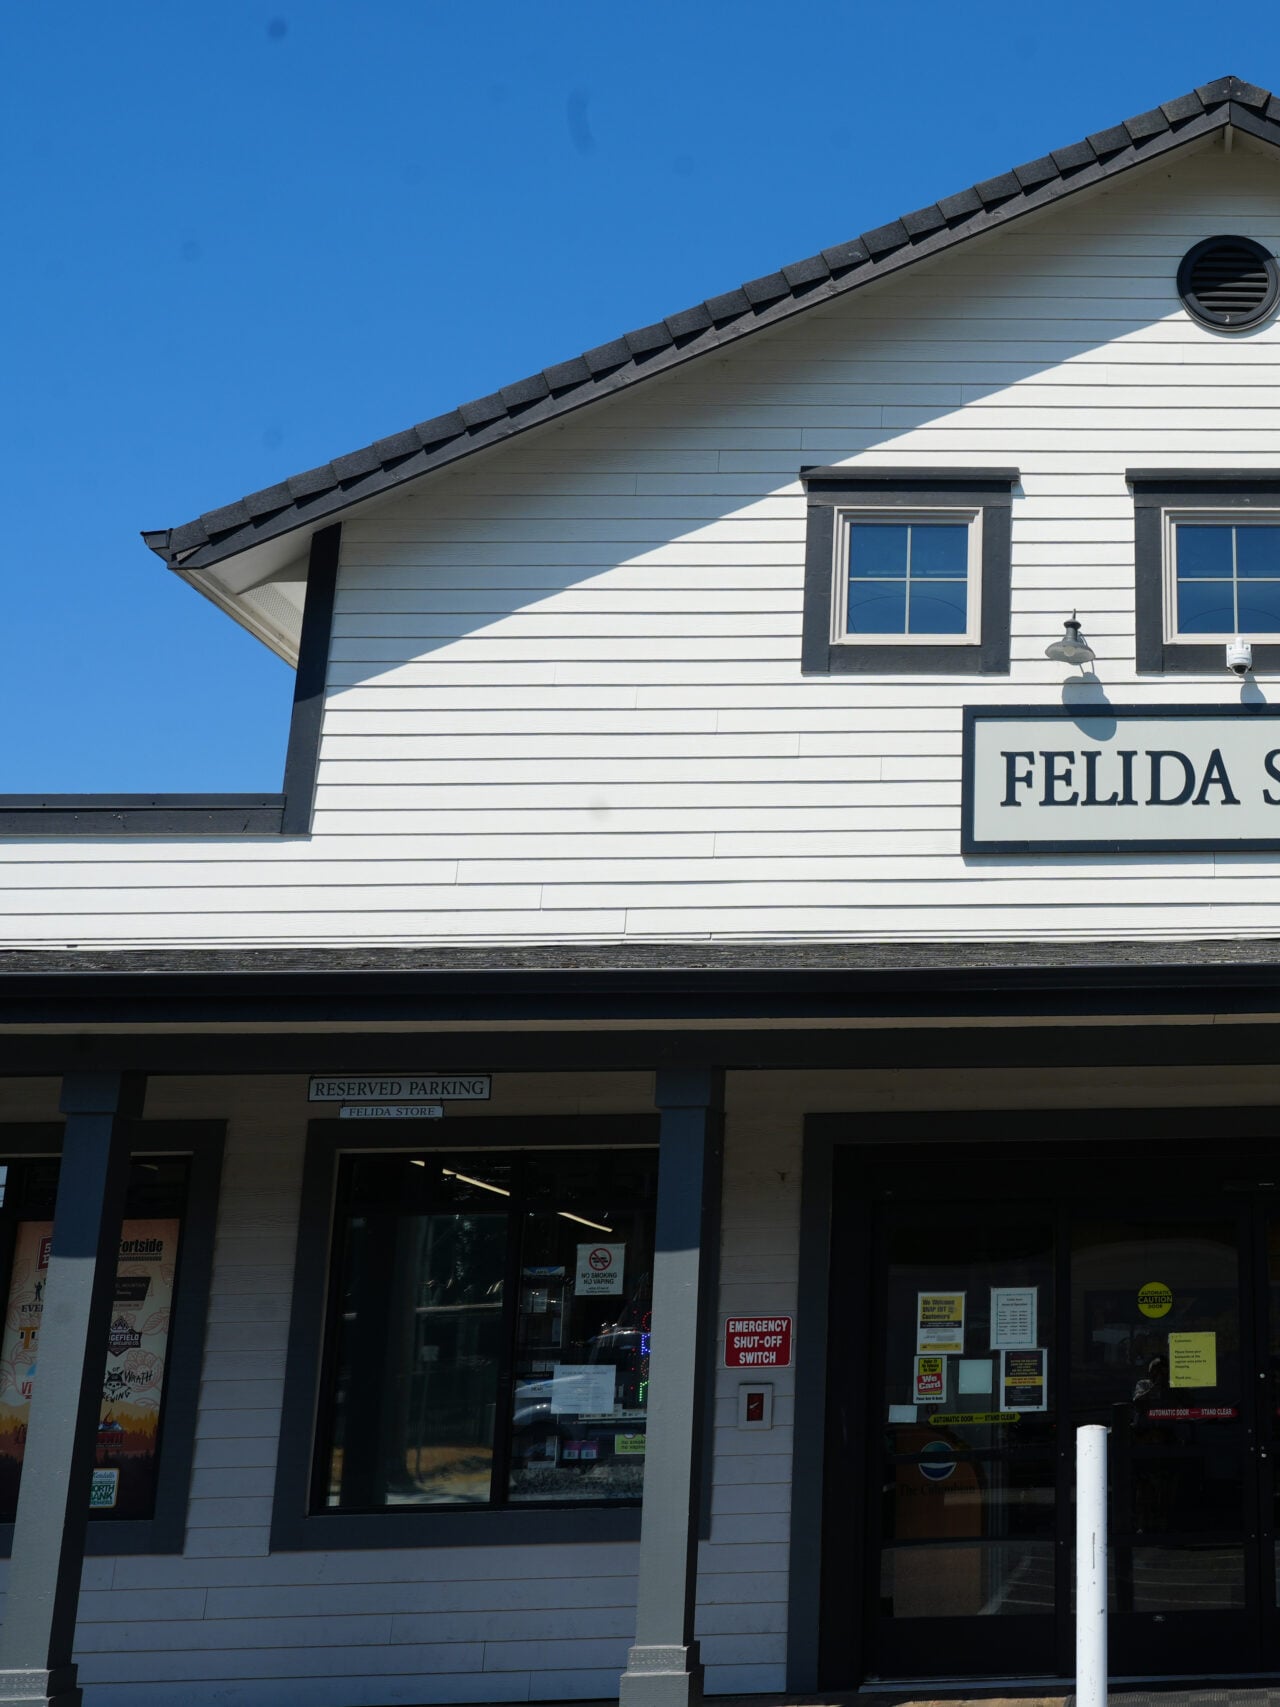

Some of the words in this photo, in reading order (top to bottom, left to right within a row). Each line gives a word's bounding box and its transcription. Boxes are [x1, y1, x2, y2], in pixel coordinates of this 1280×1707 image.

[1000, 748, 1241, 807] FELIDA
[314, 1082, 402, 1097] RESERVED
[409, 1080, 485, 1096] PARKING
[349, 1107, 392, 1117] FELIDA
[396, 1107, 435, 1116] STORE
[1138, 1296, 1173, 1304] CAUTION
[728, 1319, 788, 1333] EMERGENCY
[733, 1335, 783, 1349] SHUT-OFF
[738, 1351, 777, 1364] SWITCH
[922, 1375, 938, 1383] We
[918, 1381, 941, 1390] Card
[1149, 1408, 1176, 1417] AUTOMATIC
[1176, 1408, 1190, 1416] DOOR
[1201, 1408, 1216, 1416] STAND
